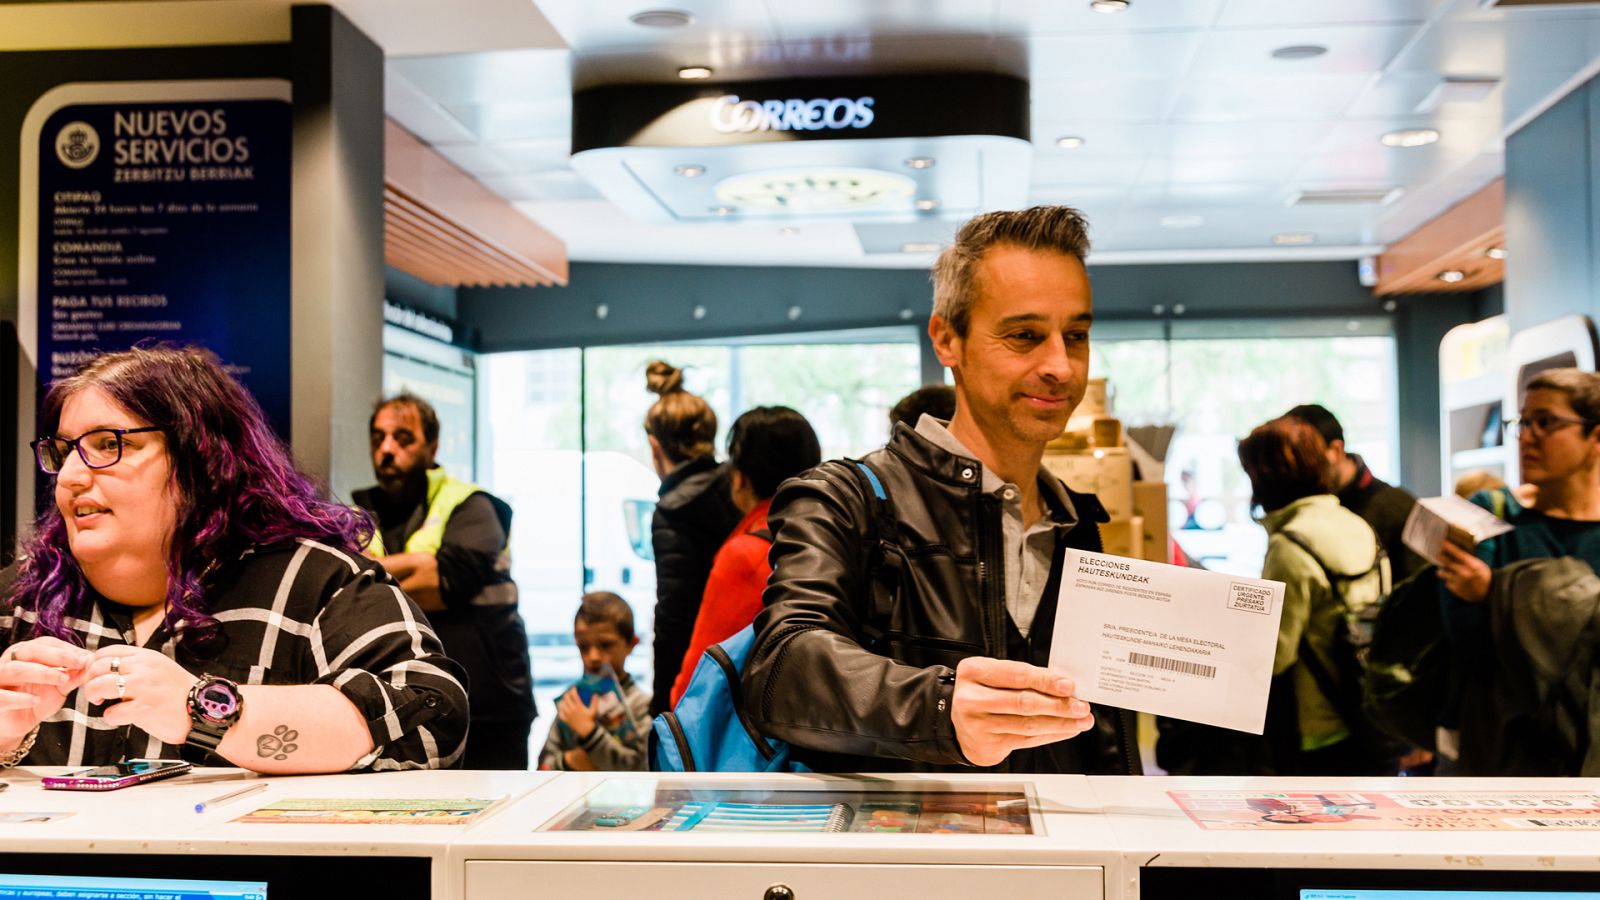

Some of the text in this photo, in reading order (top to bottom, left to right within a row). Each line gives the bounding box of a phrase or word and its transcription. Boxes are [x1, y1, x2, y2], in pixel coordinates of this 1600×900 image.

[710, 95, 875, 133] CORREOS
[114, 109, 227, 136] NUEVOS
[114, 137, 250, 165] SERVICIOS
[113, 166, 253, 182] ZERBITZU BERRIAK
[52, 295, 168, 308] PAGA TUS RECIBOS
[1079, 556, 1130, 571] ELECCIONES
[1078, 566, 1149, 584] HAUTESKUNDEAK
[1232, 584, 1270, 596] CERTIFICADO
[1237, 591, 1264, 600] URGENTE
[1233, 601, 1264, 611] ZIURTATUA
[1236, 596, 1264, 605] PRESAKO
[1192, 638, 1225, 649] ELECTORAL
